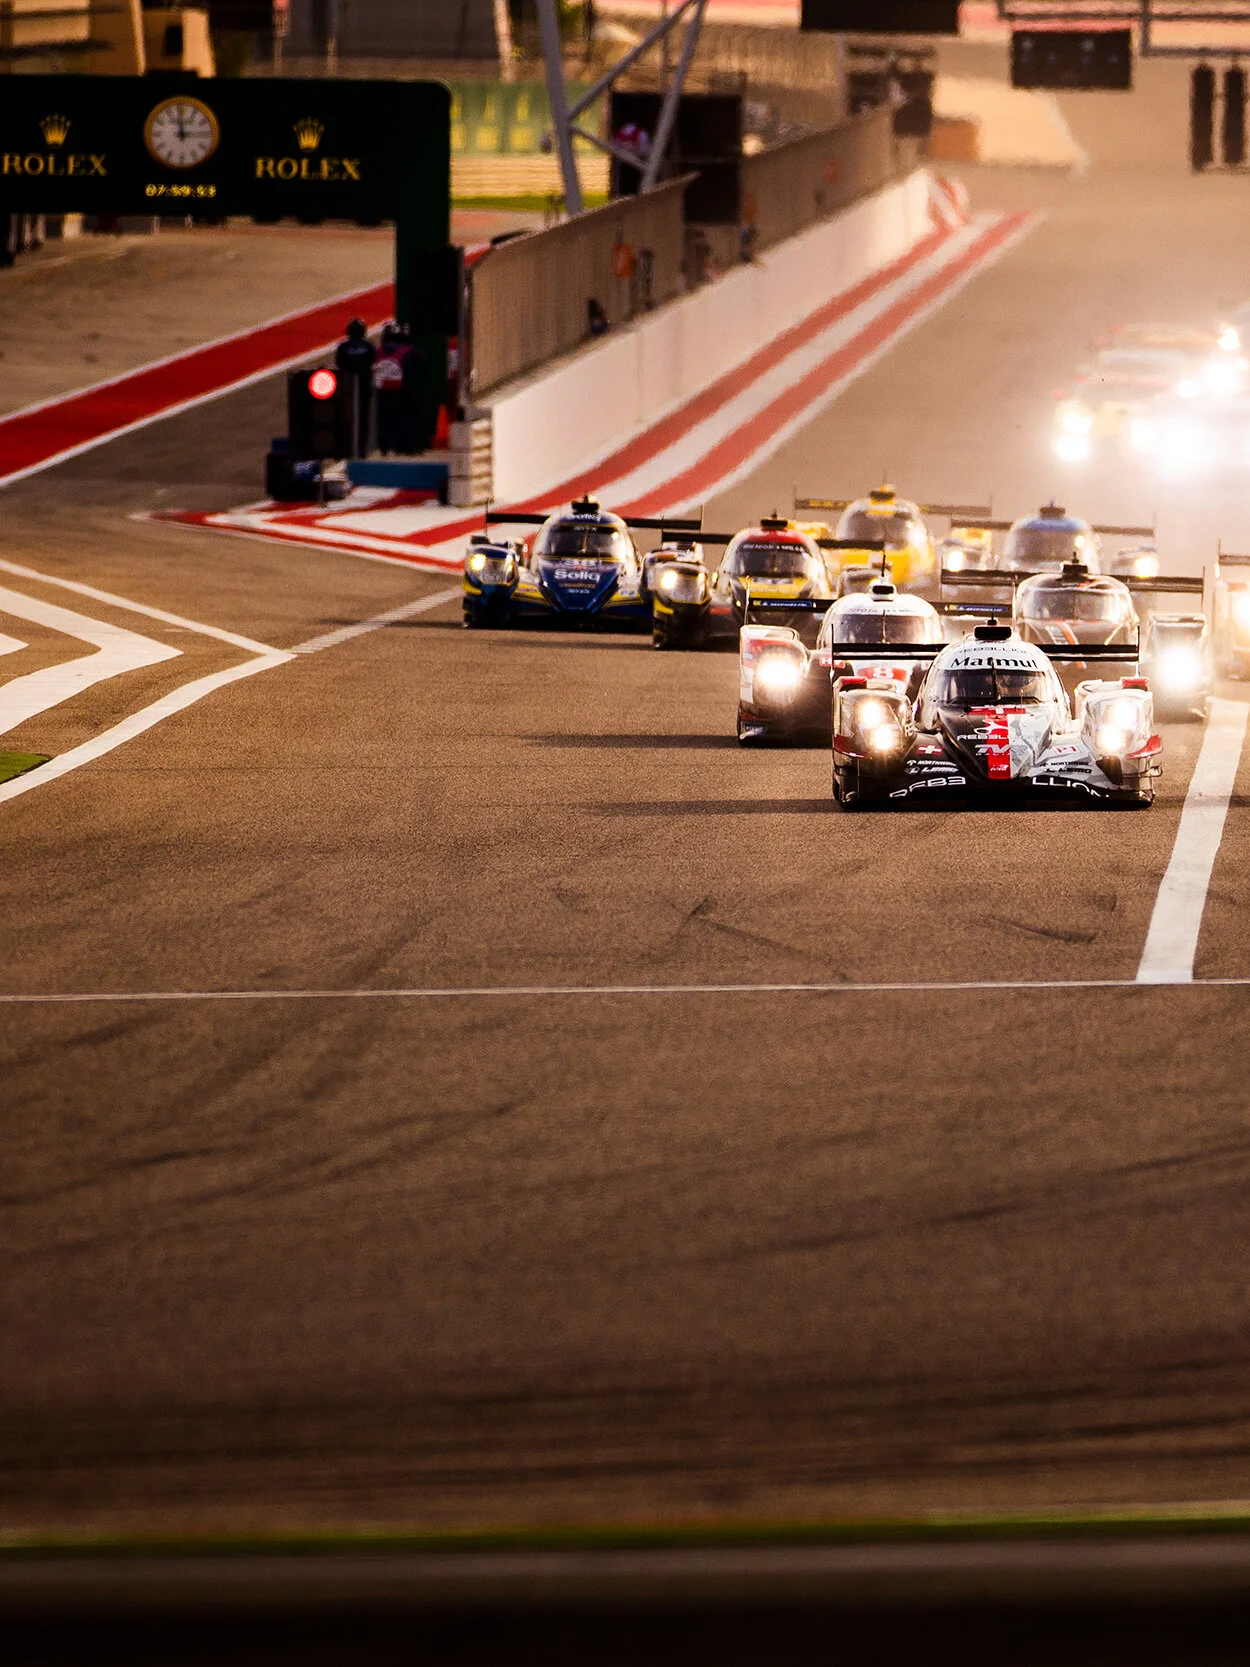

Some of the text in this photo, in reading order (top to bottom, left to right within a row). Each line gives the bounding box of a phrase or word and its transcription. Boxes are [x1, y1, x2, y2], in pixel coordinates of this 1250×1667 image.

[2, 152, 107, 176] ROLEX
[255, 157, 361, 180] ROLEX
[873, 667, 894, 679] 8
